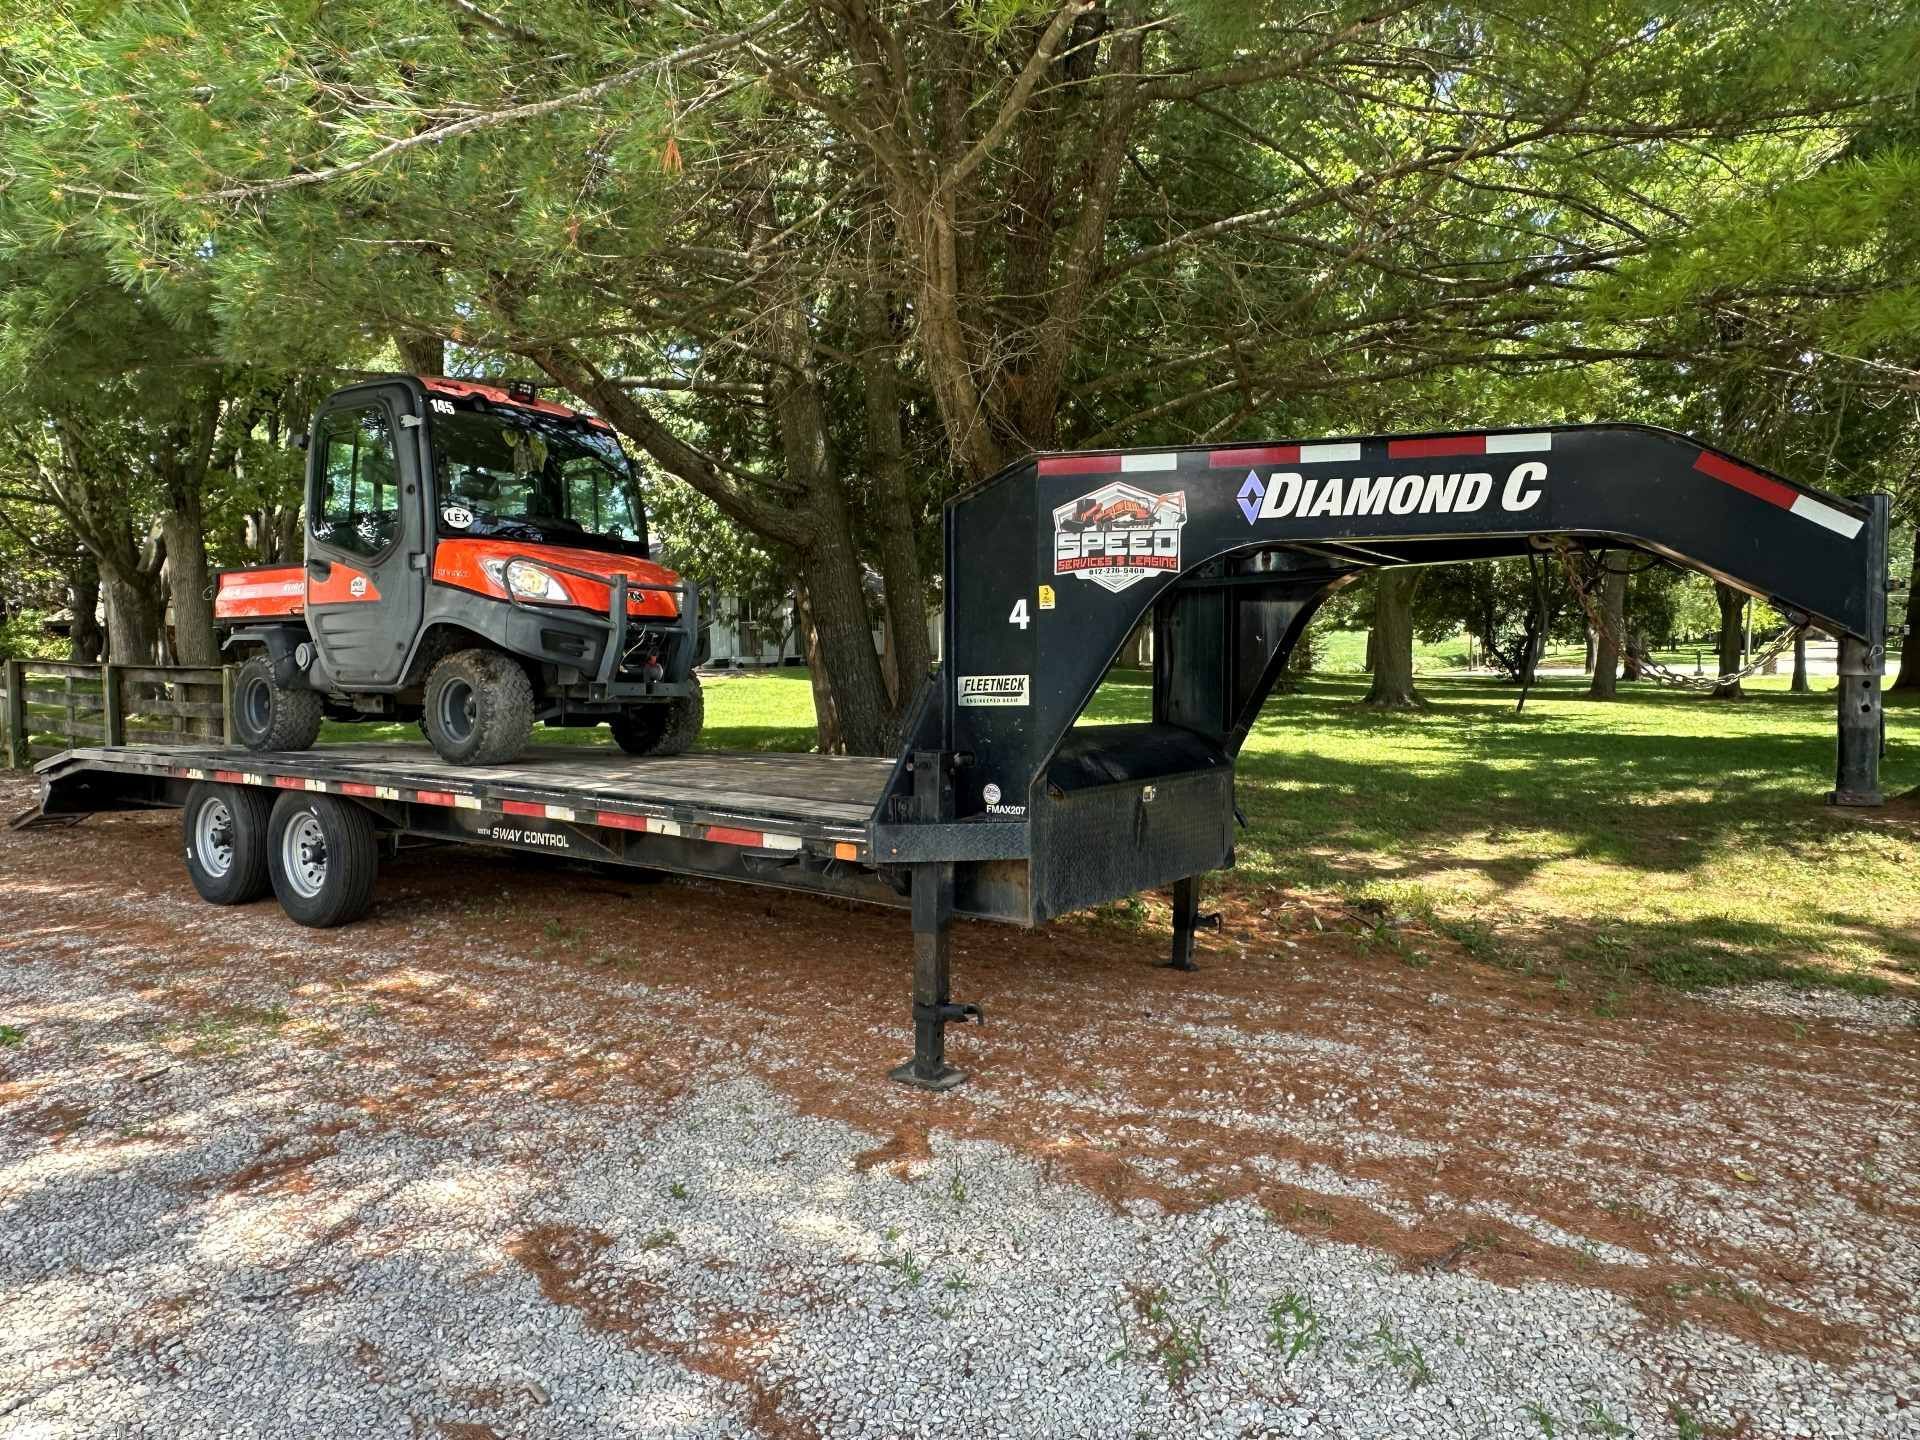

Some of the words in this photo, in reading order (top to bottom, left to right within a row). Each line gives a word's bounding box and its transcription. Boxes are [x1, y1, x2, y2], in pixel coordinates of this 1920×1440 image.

[430, 399, 455, 415] 145
[1258, 473, 1492, 519] DIAMOND
[1501, 461, 1548, 512] C
[447, 512, 470, 522] LEX
[1057, 530, 1178, 560] SPEED
[1058, 556, 1112, 570] SERVICES
[1130, 556, 1177, 568] LEASING
[1008, 599, 1030, 630] 4
[964, 677, 1026, 692] FLEETNECK
[986, 804, 1026, 816] FMAX207
[492, 827, 522, 842] SWAY
[524, 831, 570, 848] CONTROL
